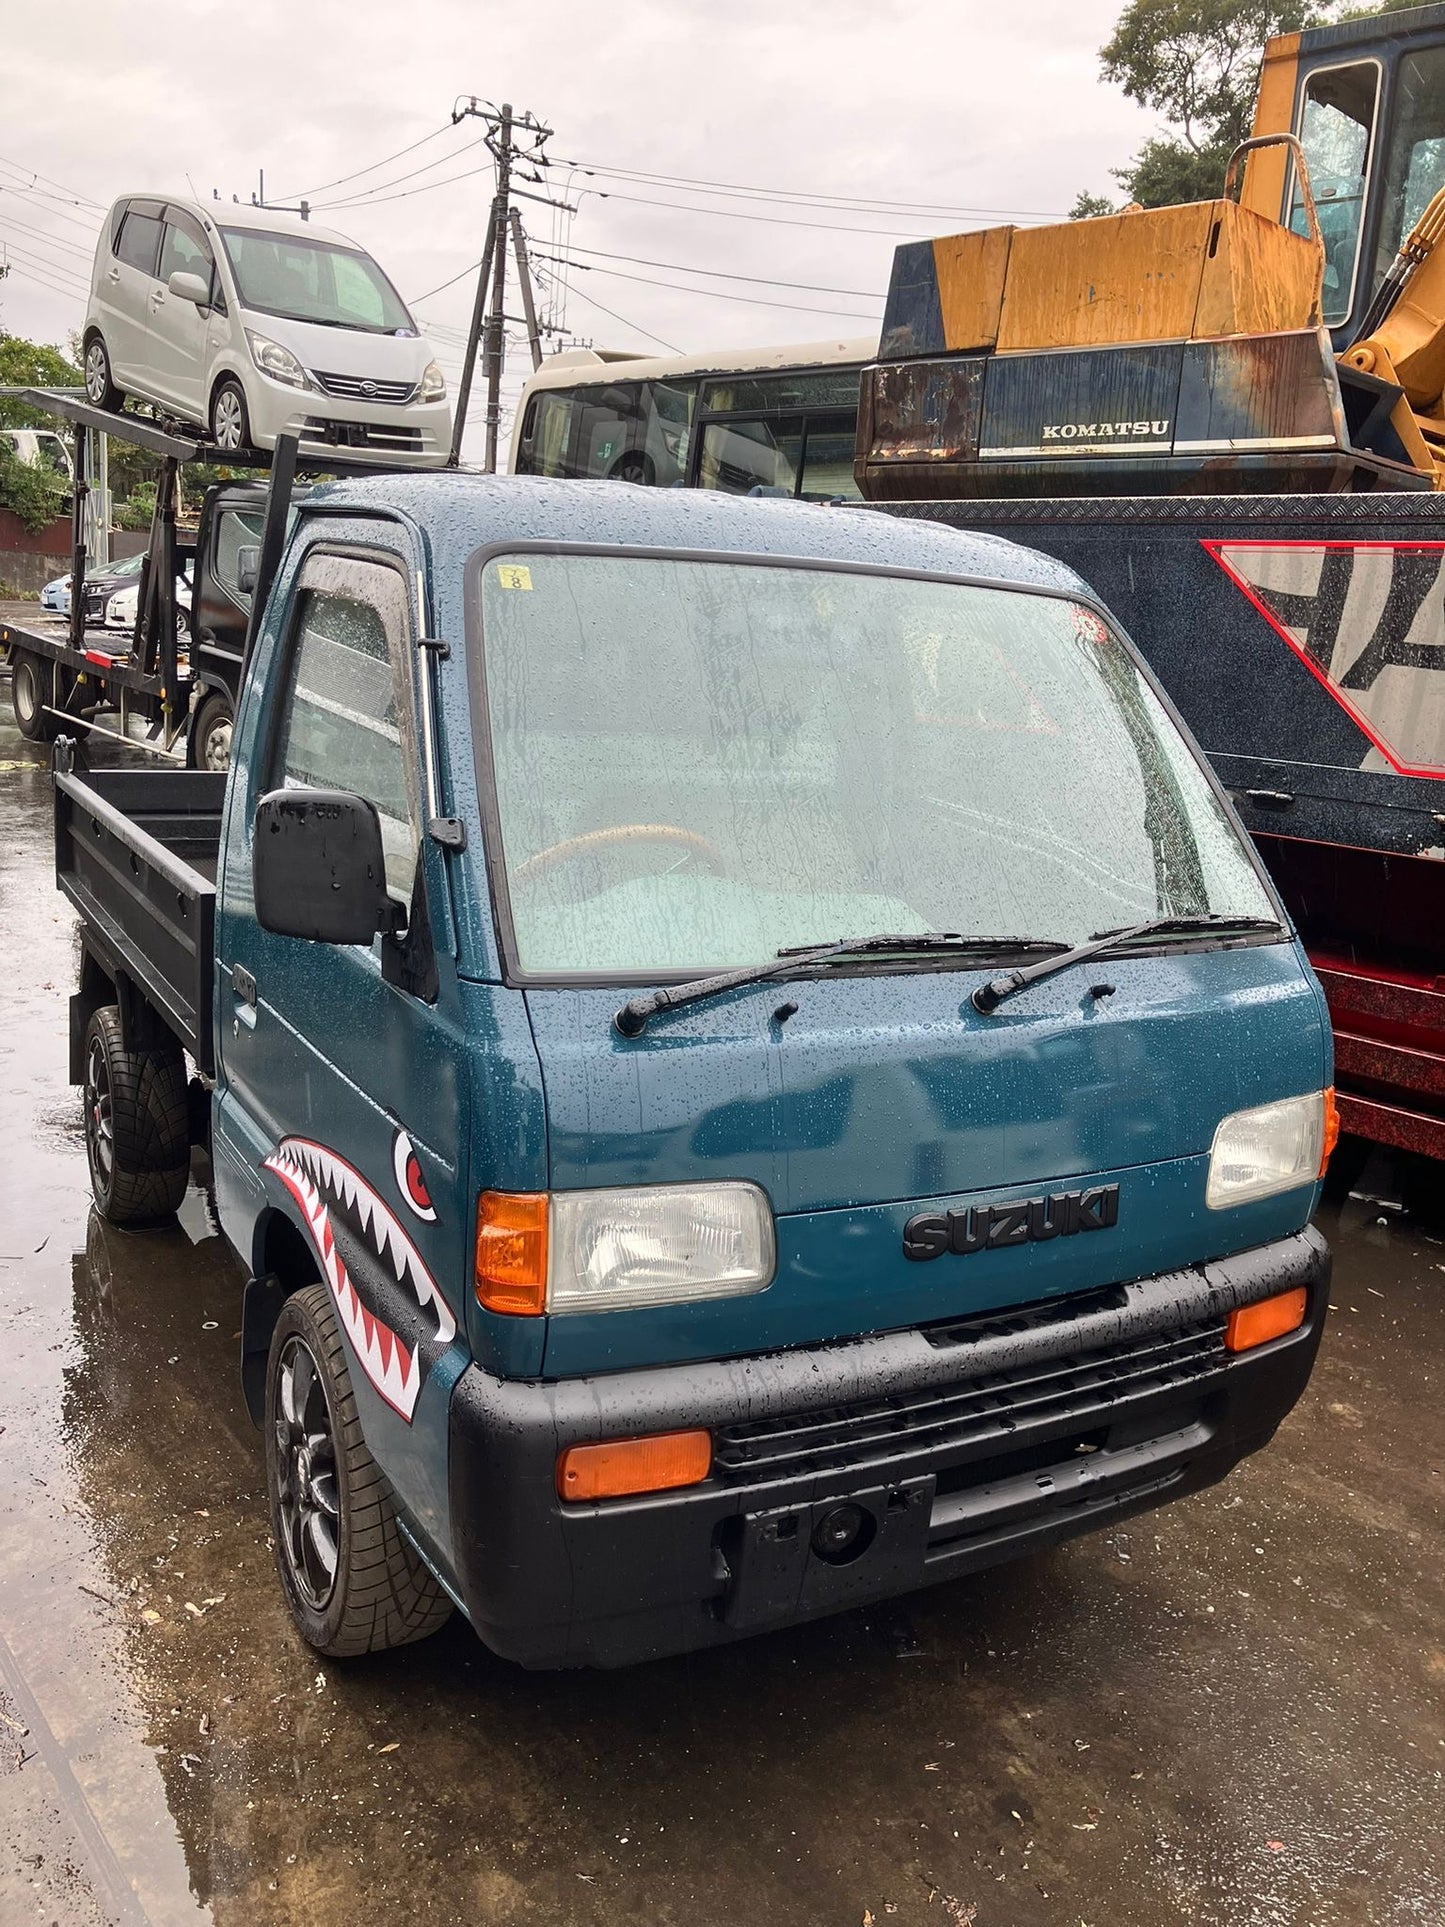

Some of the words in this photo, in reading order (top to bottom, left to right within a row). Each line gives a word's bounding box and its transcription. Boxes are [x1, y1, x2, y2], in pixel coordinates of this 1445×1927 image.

[1042, 420, 1169, 439] KOMATSU
[511, 577, 521, 588] 8
[903, 1182, 1119, 1262] SUZUKI
